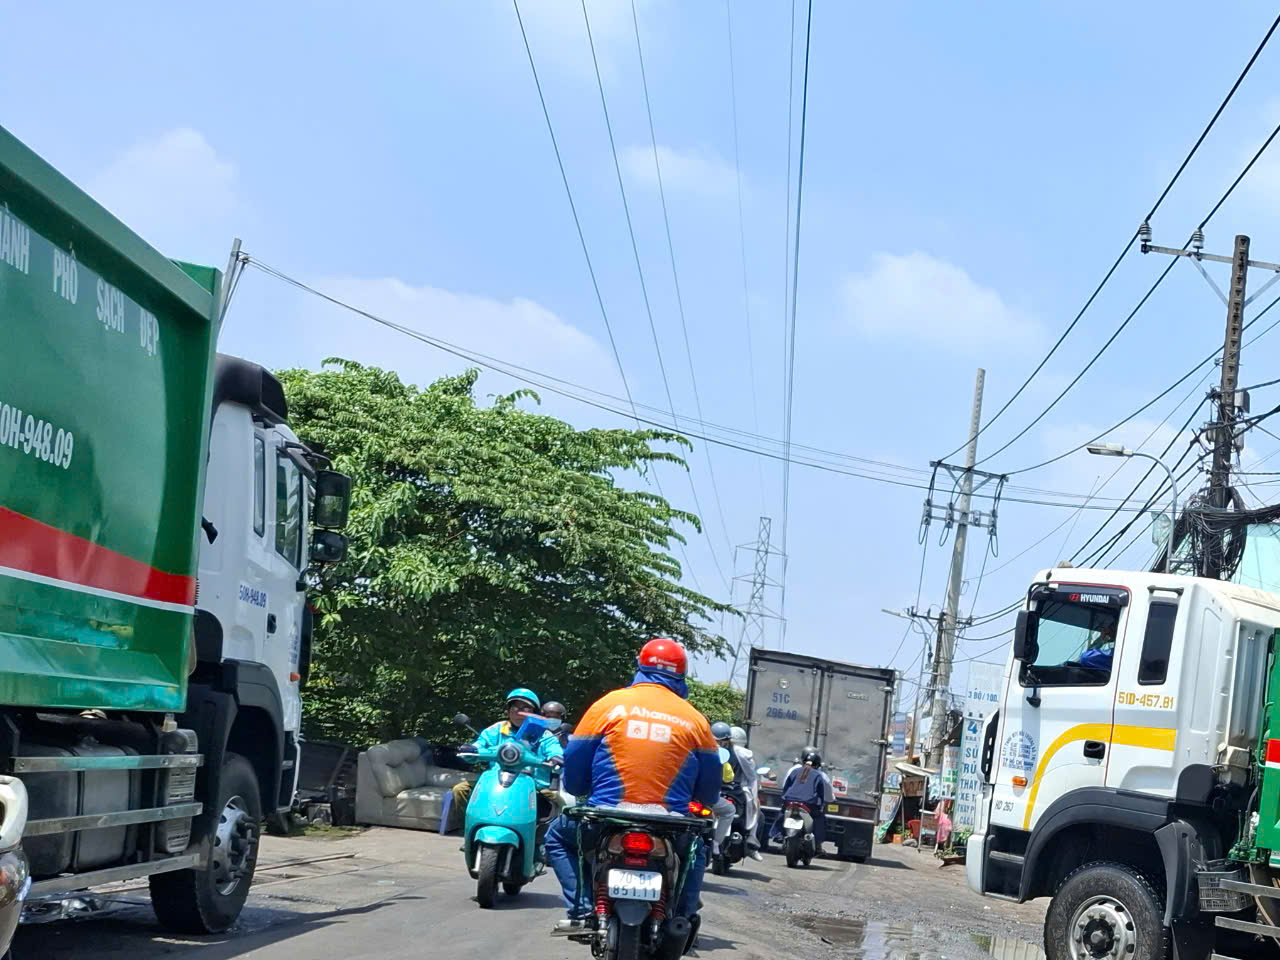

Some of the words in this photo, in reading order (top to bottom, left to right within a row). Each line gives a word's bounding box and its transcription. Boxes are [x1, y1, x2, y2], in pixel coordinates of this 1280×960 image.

[0, 201, 30, 275] ÀNH
[96, 277, 125, 334] SẠCH
[140, 308, 160, 357] ĐẸP
[0, 401, 74, 470] 0H-948.09
[1080, 593, 1110, 604] HYUNDAI
[771, 692, 791, 705] 51C
[1118, 691, 1174, 709] 51D-457.81
